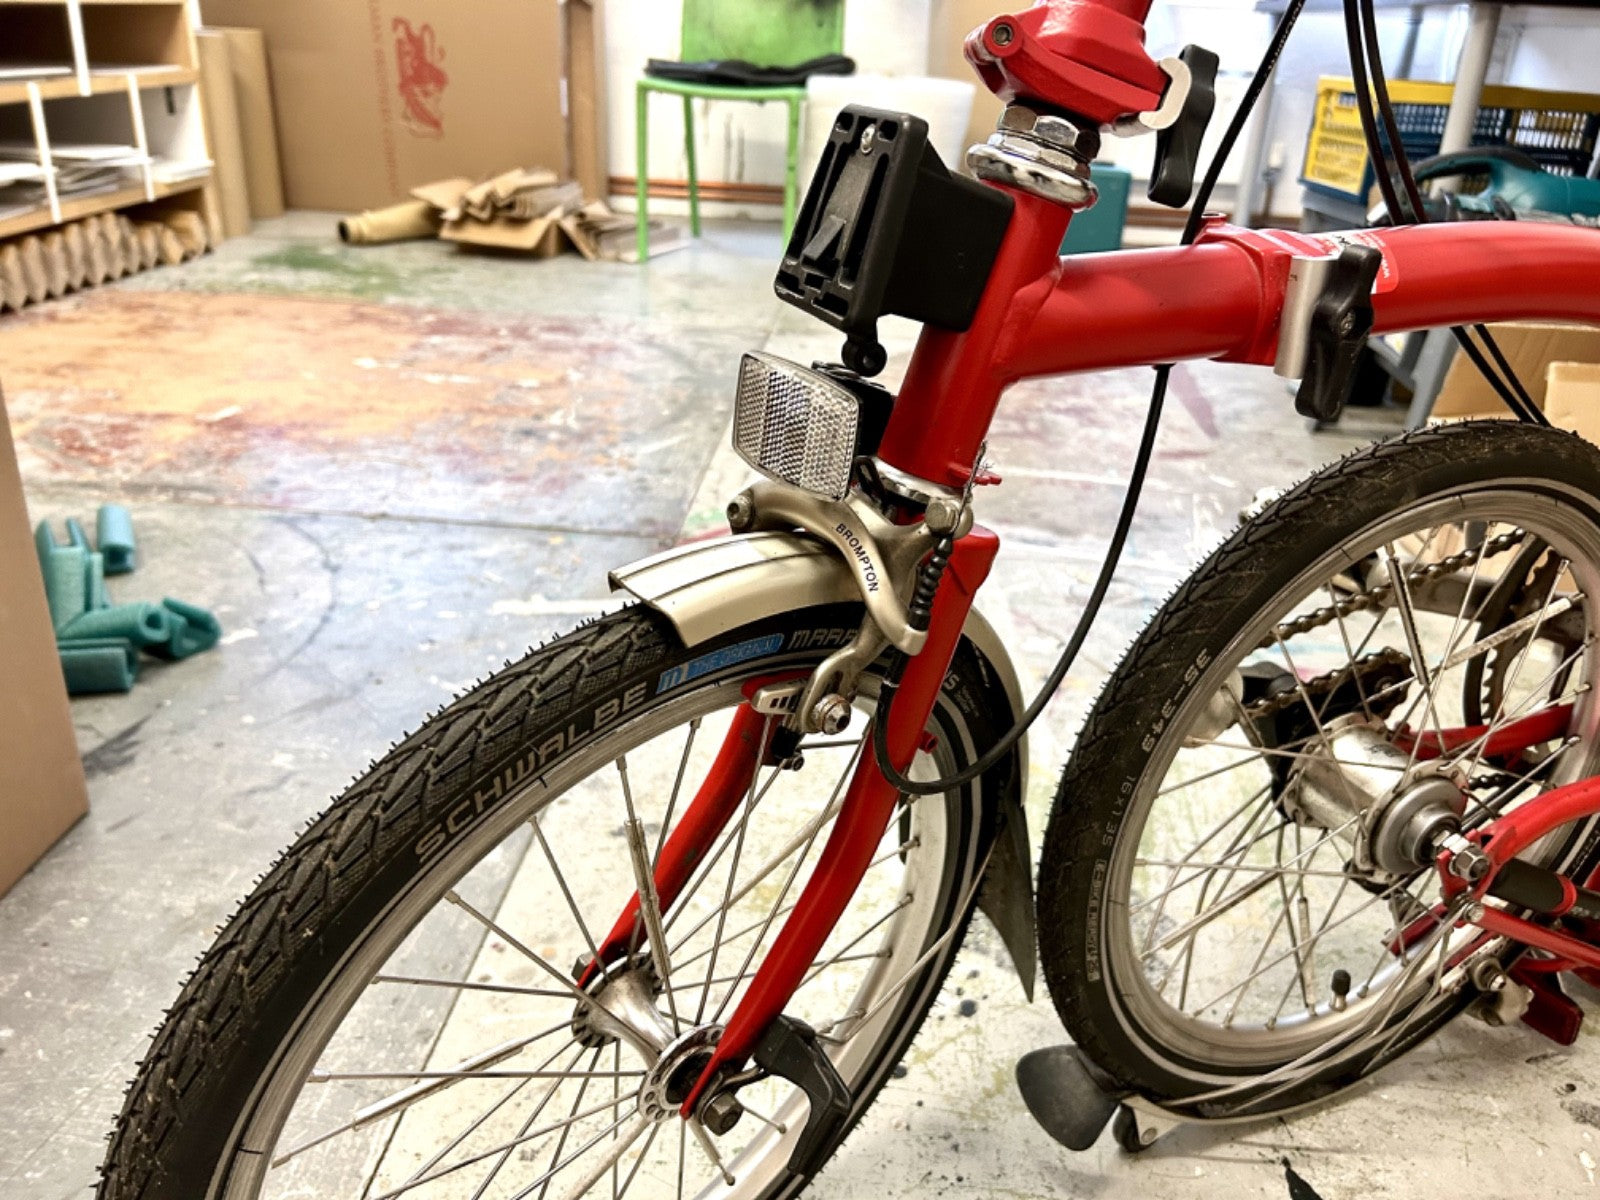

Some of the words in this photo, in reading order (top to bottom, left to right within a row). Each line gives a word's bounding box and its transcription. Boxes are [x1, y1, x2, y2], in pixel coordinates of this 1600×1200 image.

[836, 522, 879, 593] BROMPTON
[786, 627, 859, 650] MARA
[1141, 649, 1212, 753] 35-349
[414, 682, 648, 855] SCHWALBE
